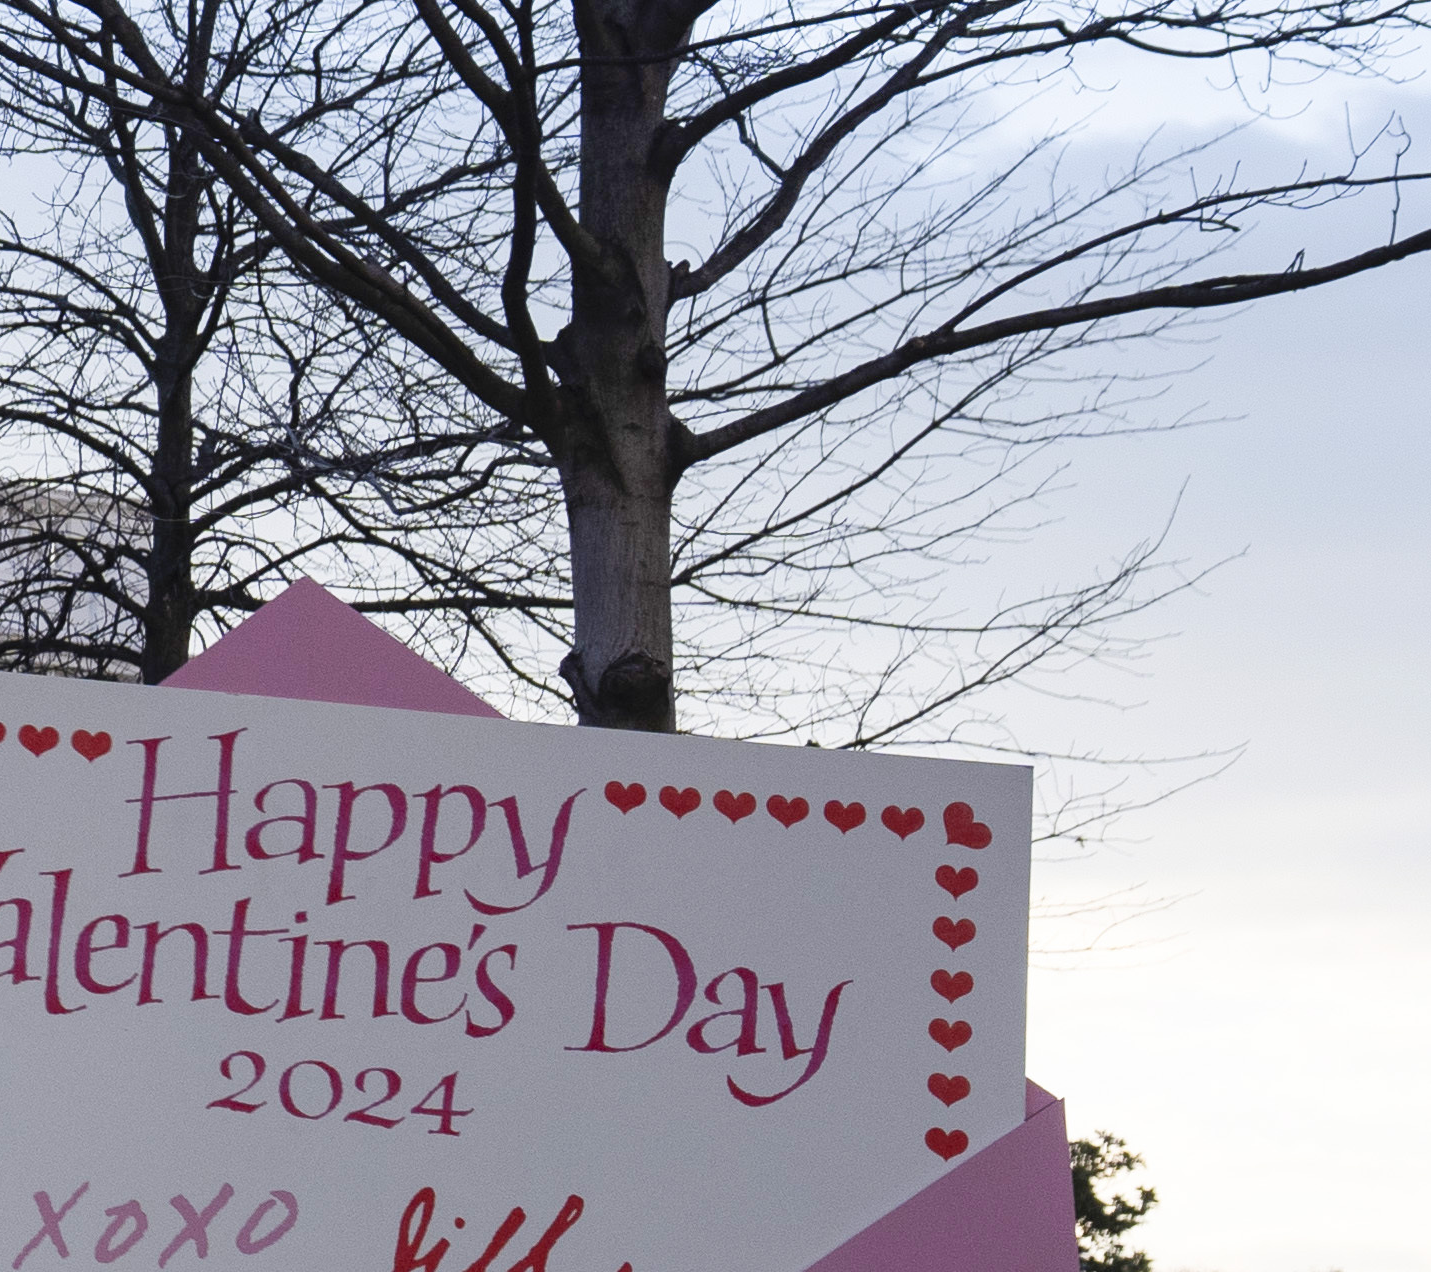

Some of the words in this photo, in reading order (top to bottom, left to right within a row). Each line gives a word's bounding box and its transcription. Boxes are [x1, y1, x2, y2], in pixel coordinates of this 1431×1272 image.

[118, 727, 587, 915] Happy
[205, 1050, 473, 1136] 2024
[563, 920, 854, 1107] Day
